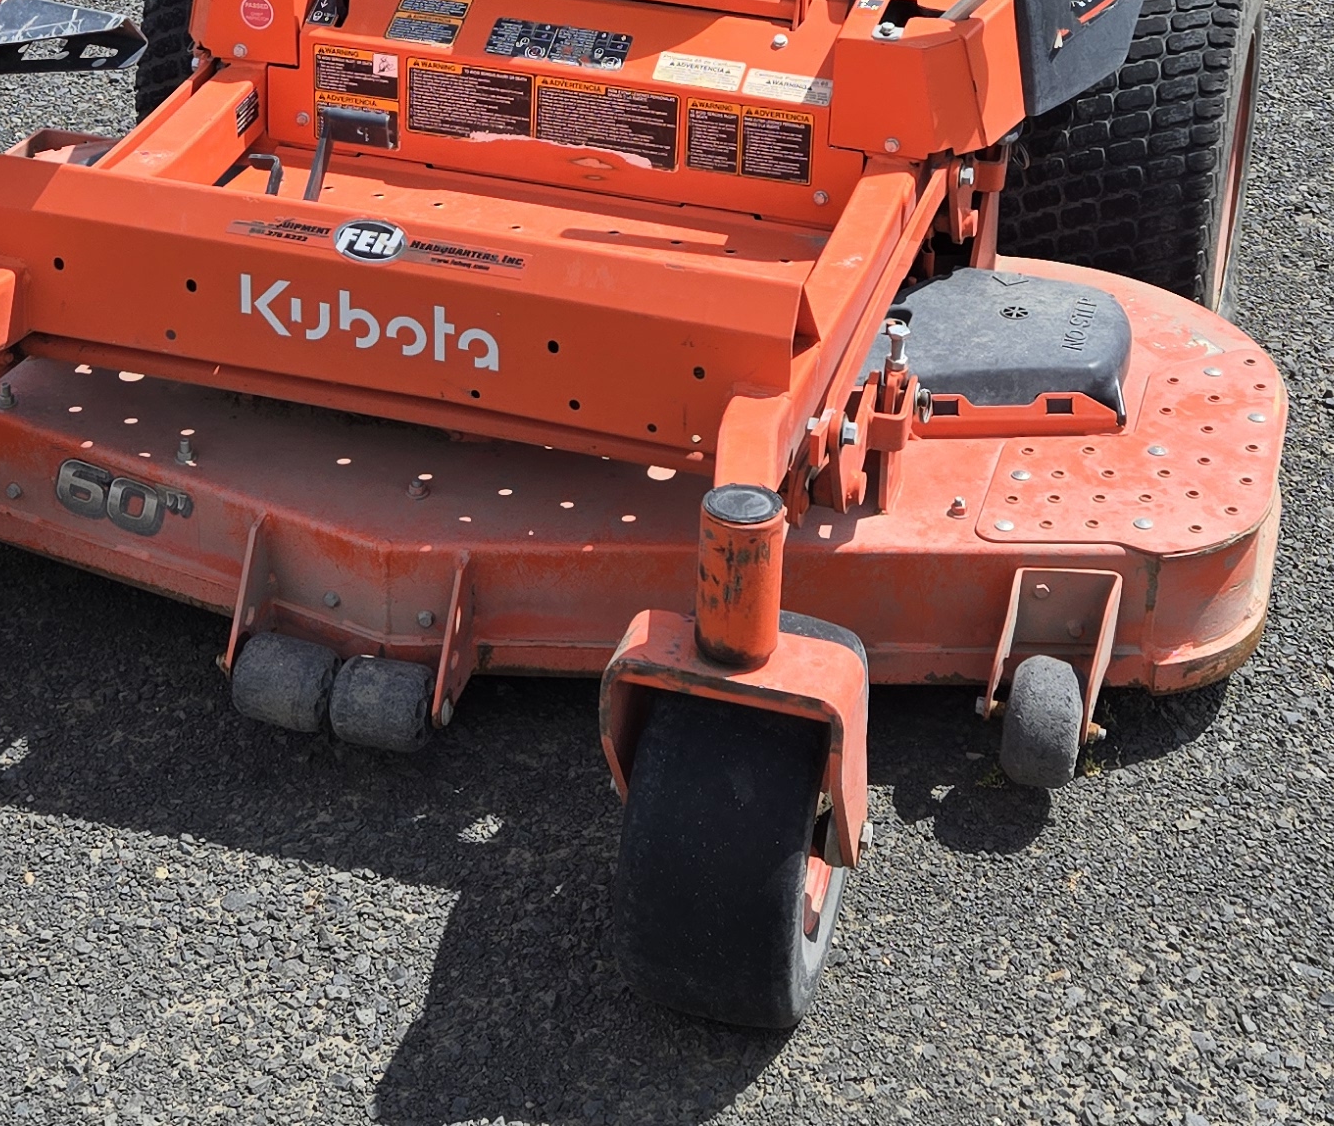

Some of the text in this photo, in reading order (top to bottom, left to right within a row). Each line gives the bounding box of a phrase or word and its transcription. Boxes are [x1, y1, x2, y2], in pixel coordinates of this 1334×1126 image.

[244, 1, 269, 10] PASSED
[324, 47, 360, 58] WARNING
[420, 61, 456, 72] WARNING
[676, 61, 724, 74] ADVERTENCIA
[549, 78, 602, 93] ADVERTENCIA
[772, 79, 807, 90] WARNING
[326, 94, 377, 108] ADVERTENCIA
[697, 101, 734, 112] WARNING
[754, 109, 810, 123] ADVERTENCIA
[335, 226, 405, 256] FEH
[239, 272, 500, 372] Kubota
[1061, 329, 1087, 351] NO
